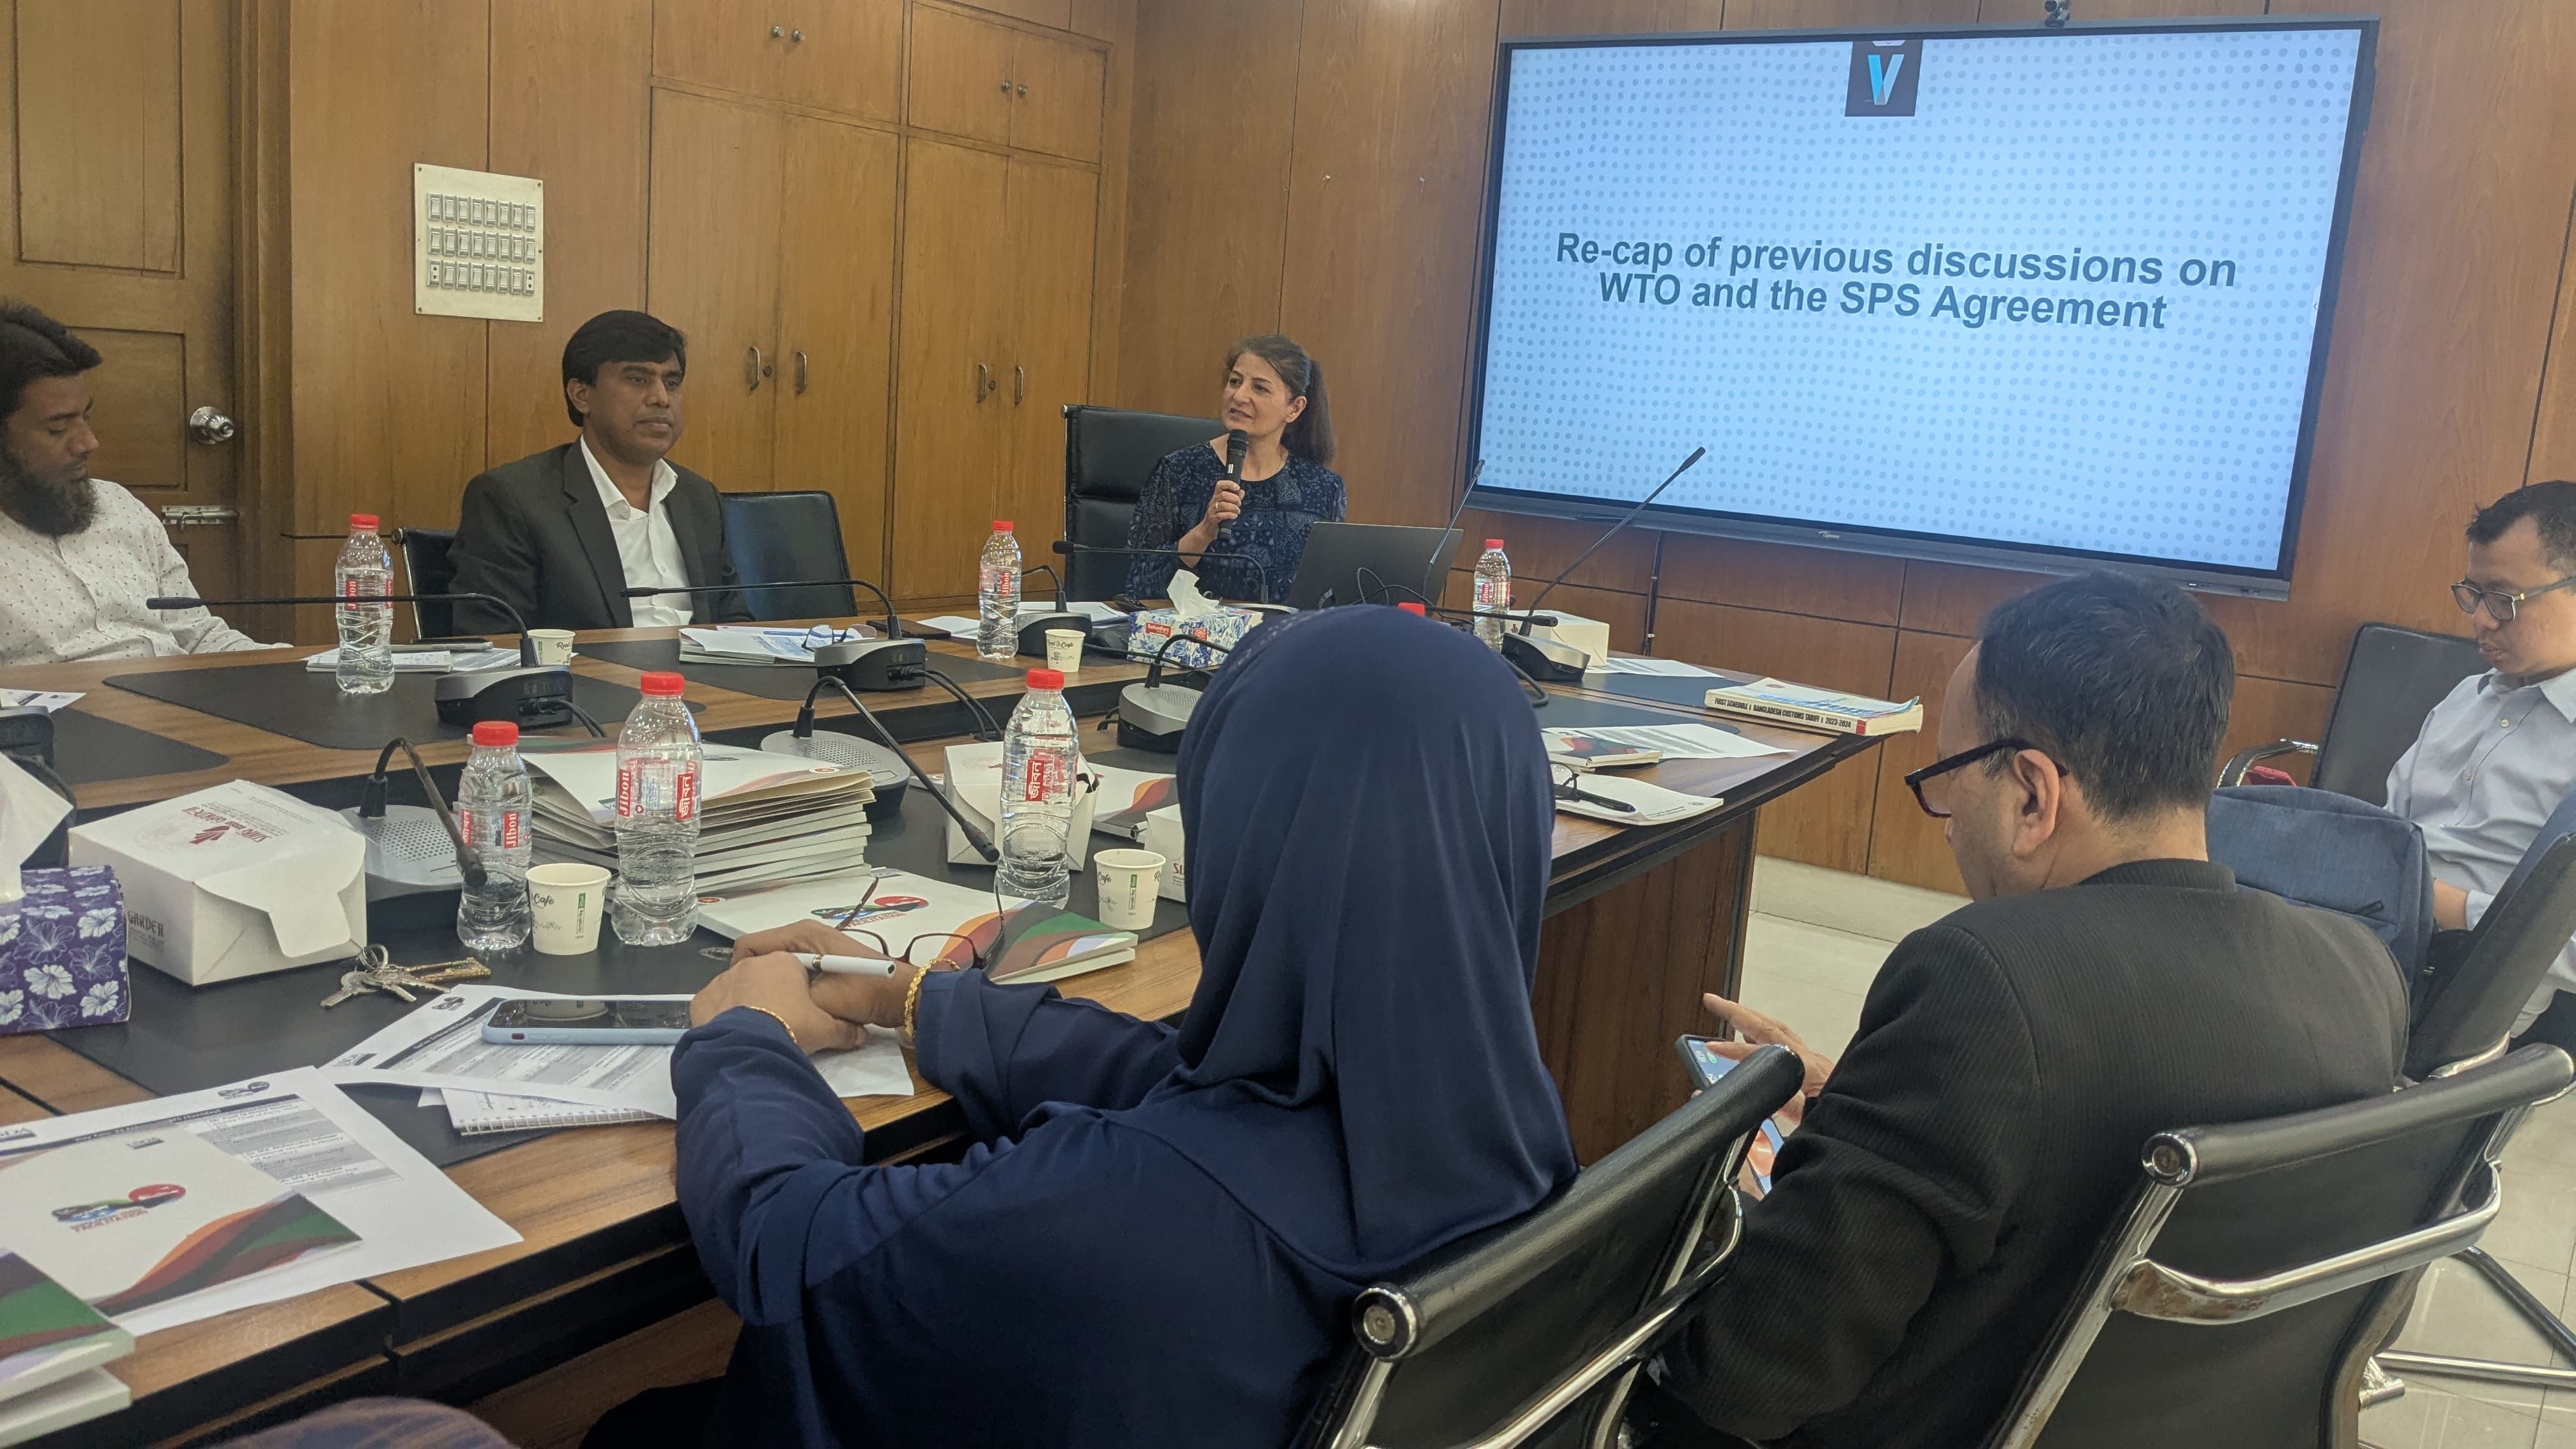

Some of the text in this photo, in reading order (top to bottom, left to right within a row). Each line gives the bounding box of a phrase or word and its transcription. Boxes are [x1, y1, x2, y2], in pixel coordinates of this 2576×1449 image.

[1556, 233, 2237, 287] Re-cap of previous discussions on
[1599, 272, 2168, 329] WTO and the SPS Agreement
[348, 581, 357, 610] Jon
[1715, 698, 1727, 706] FIRST
[1727, 700, 1748, 710] SCHEDULE
[1753, 705, 1782, 716] BANGLADESH
[1782, 710, 1804, 719] CUSTOMS
[1805, 714, 1820, 722] TARIFF
[1825, 717, 1851, 728] 2023-2024
[619, 772, 629, 815] Jibon
[678, 776, 691, 818] জীবন
[1028, 760, 1042, 799] জীবন
[505, 812, 518, 847] Jibon
